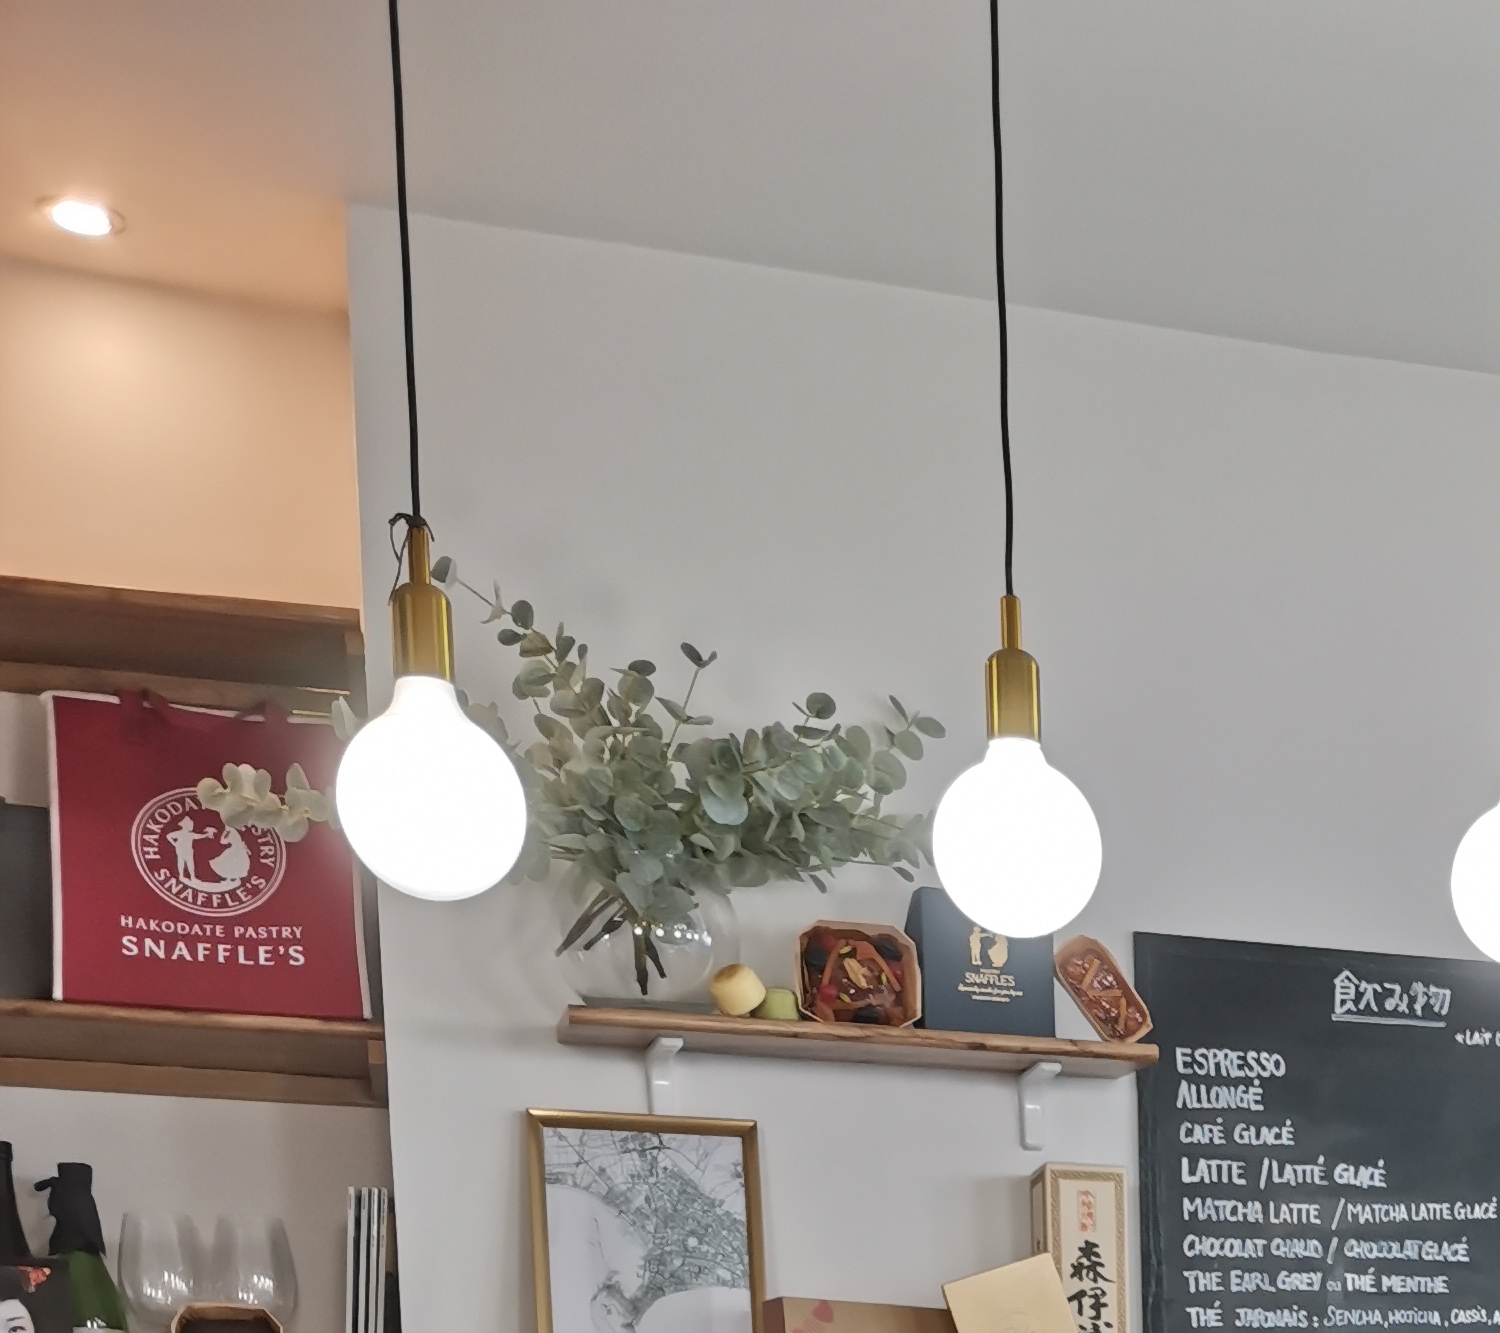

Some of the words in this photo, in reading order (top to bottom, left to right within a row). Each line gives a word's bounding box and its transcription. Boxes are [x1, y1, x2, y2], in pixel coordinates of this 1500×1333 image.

[154, 867, 267, 908] SNAFFLE'S
[120, 914, 226, 938] HAKODATE
[233, 925, 303, 940] PASTRY
[121, 935, 306, 967] SNAFFLE'S
[1333, 967, 1452, 1018] 飲み物
[1175, 1046, 1287, 1079] ESPRESSO
[1176, 1078, 1265, 1112] ALLONGÉ
[1179, 1116, 1227, 1145] CAFÉ
[1233, 1117, 1296, 1146] GLACÉ
[1180, 1155, 1248, 1186] LATTE
[1333, 1158, 1388, 1189] GLACÉ
[1182, 1196, 1263, 1224] MATCHA
[1269, 1200, 1321, 1225] LATTE
[1410, 1202, 1453, 1222] LATTE
[1453, 1195, 1498, 1220] GLACÉ
[1182, 1233, 1268, 1259] CHOCOLAT
[1270, 1237, 1323, 1259] CHAUD
[1343, 1238, 1421, 1260] CHOCOLAT
[1420, 1235, 1471, 1263] GLACÉ
[1229, 1269, 1277, 1293] EARL
[1276, 1270, 1323, 1292] GREY
[1344, 1266, 1378, 1294] THÉ
[1381, 1274, 1450, 1294] MENTHE
[1185, 1299, 1224, 1329] THÉ
